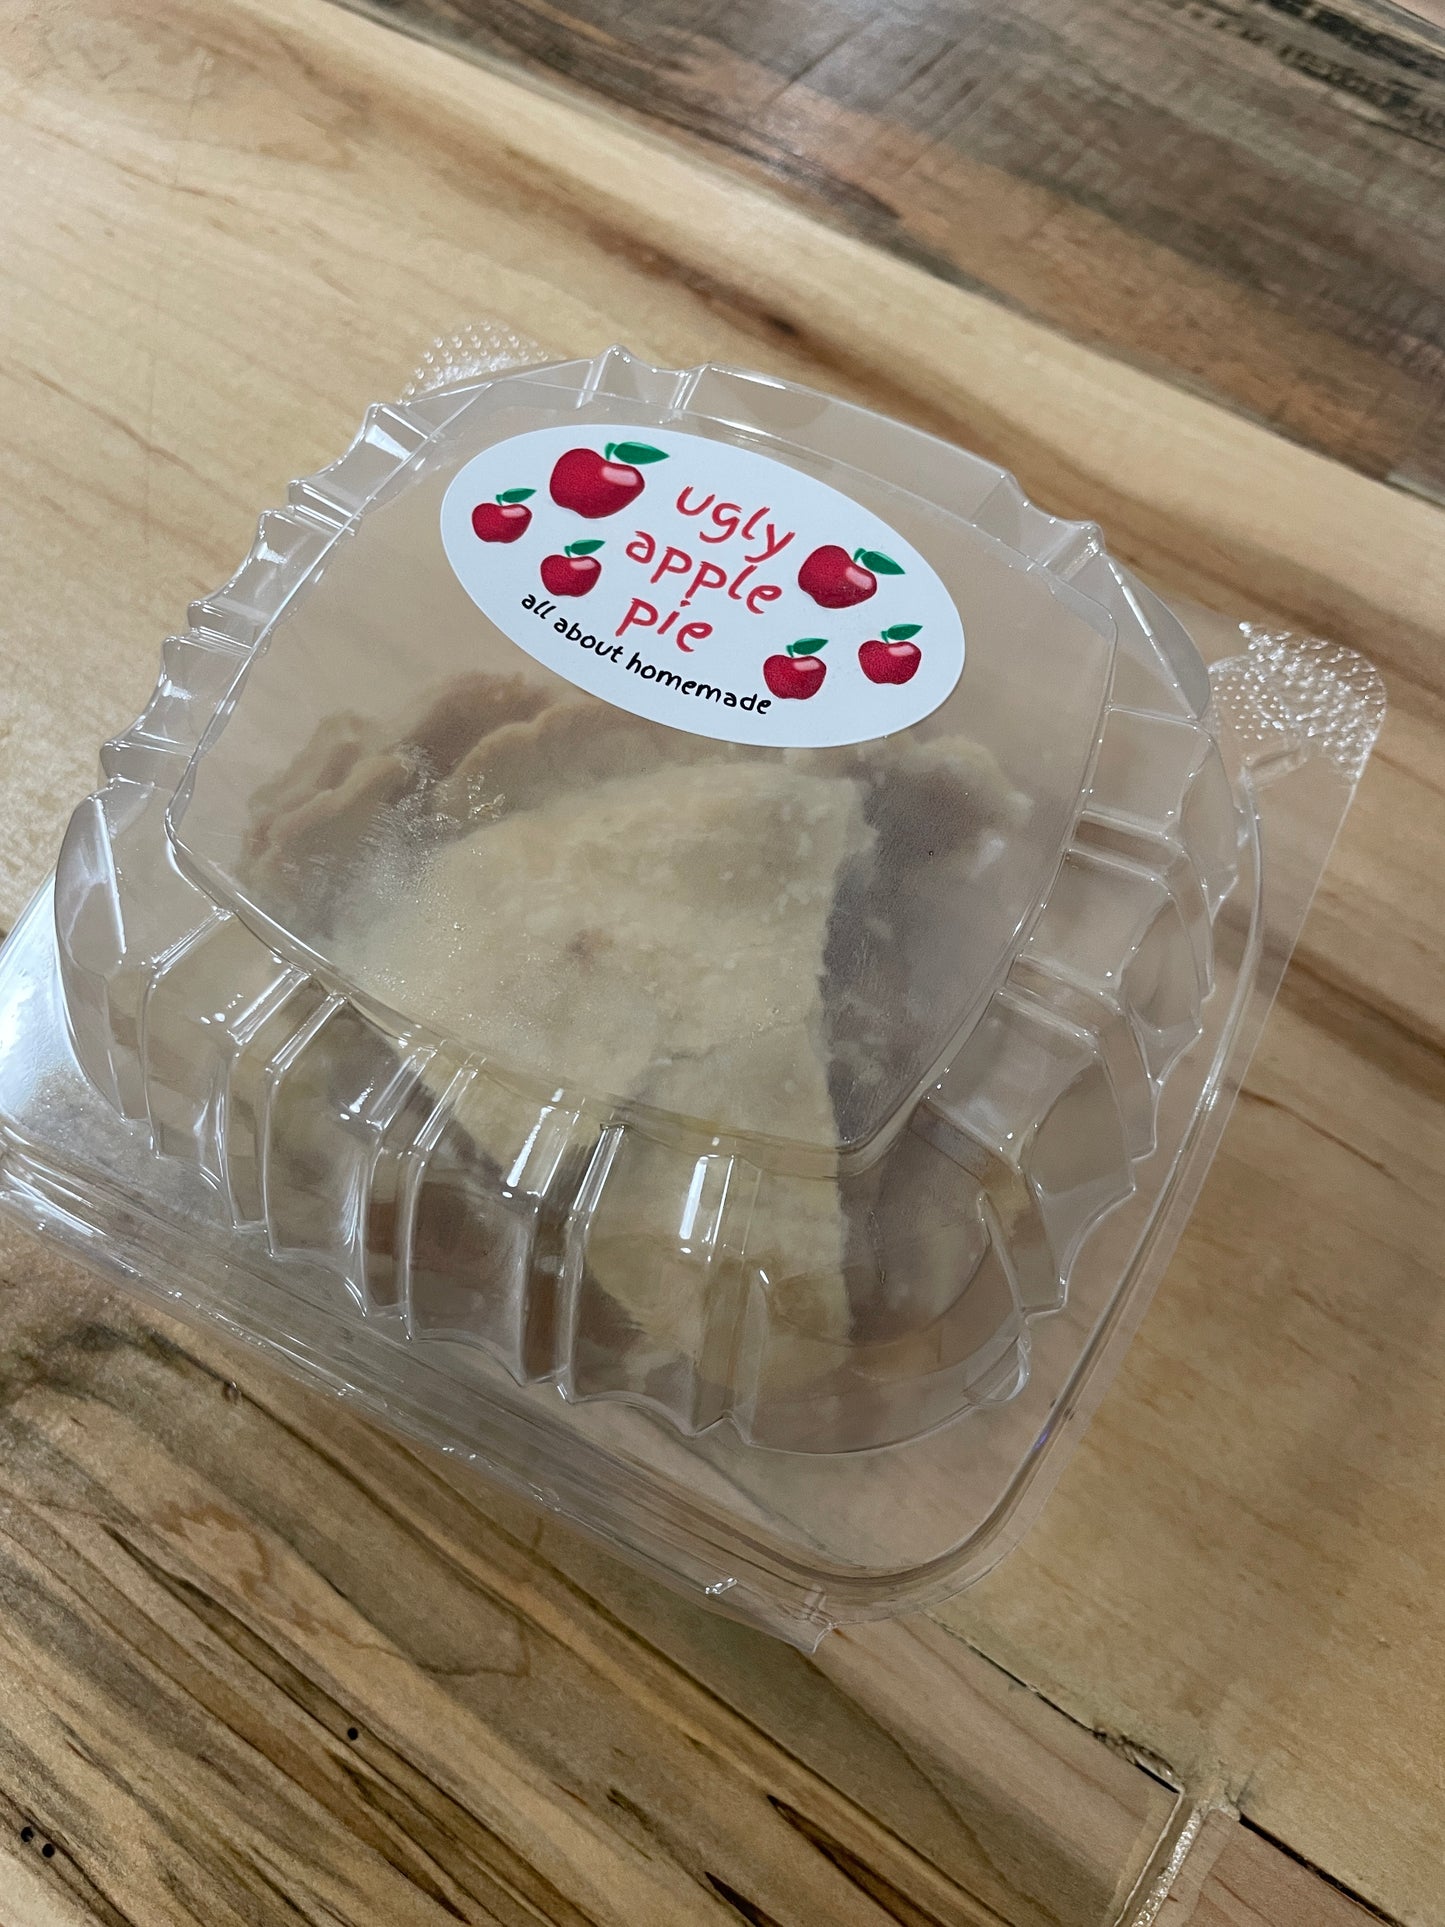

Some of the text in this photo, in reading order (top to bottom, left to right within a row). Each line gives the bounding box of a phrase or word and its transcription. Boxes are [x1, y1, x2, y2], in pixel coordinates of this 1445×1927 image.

[676, 486, 796, 564] ugly
[625, 530, 783, 615] apple
[521, 593, 772, 715] all about homemade
[615, 597, 713, 653] pie
